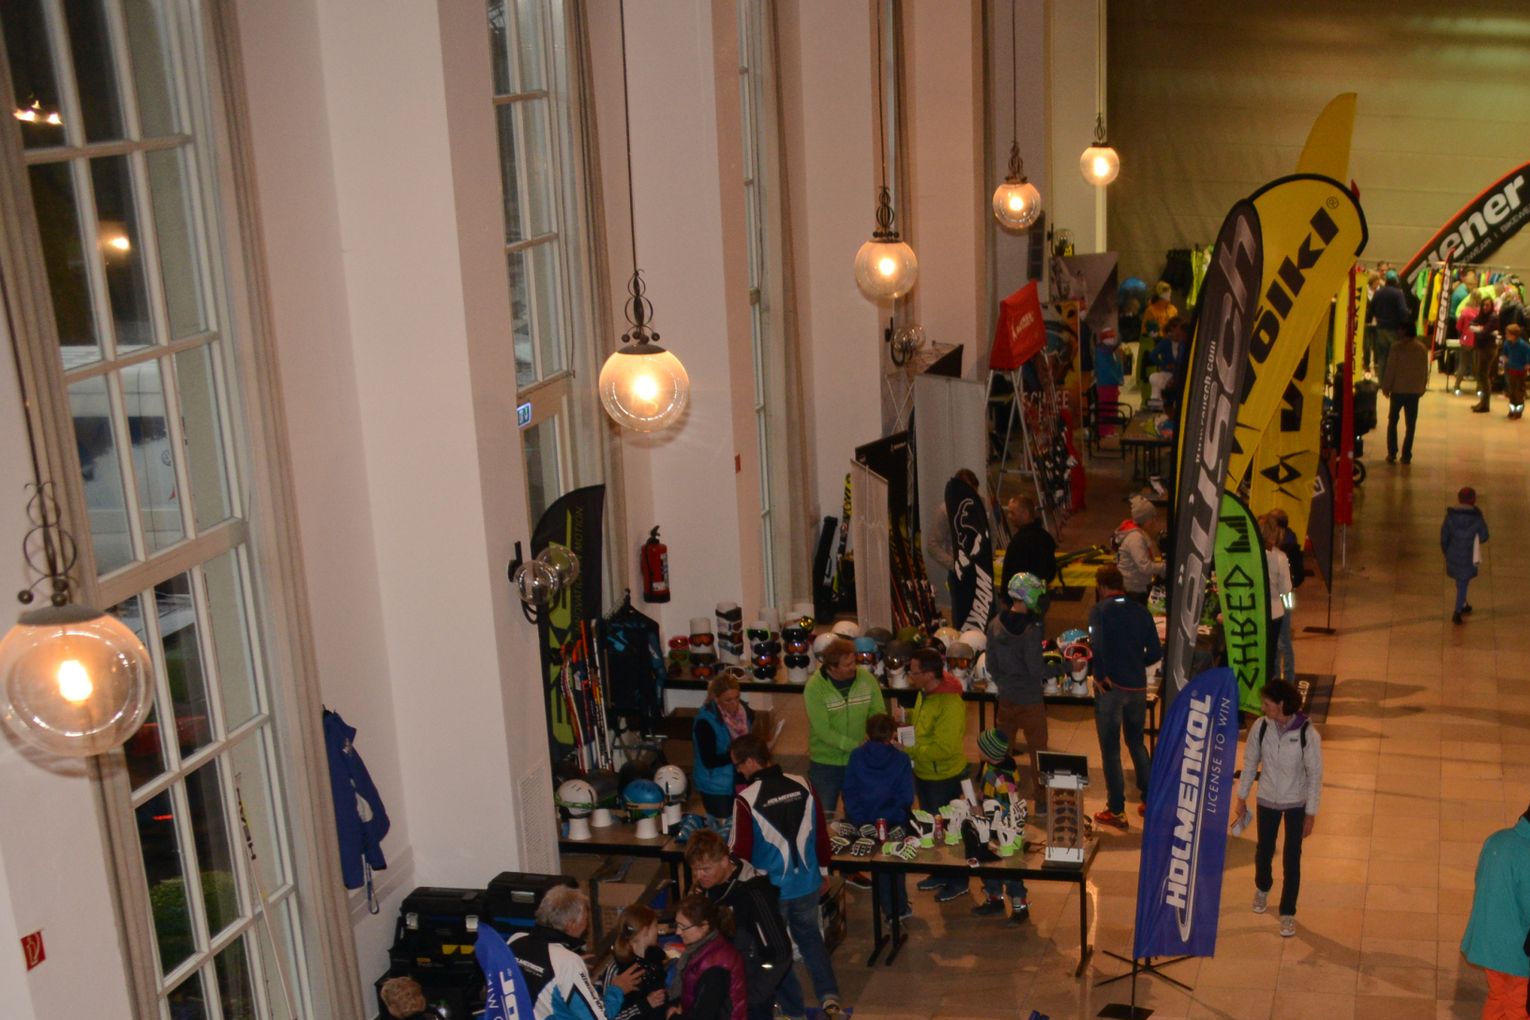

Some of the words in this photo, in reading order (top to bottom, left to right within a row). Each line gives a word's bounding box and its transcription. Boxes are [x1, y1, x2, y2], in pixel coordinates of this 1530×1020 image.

[1173, 213, 1256, 691] reusch
[1220, 697, 1231, 726] WIN
[1214, 732, 1226, 750] TO
[1165, 694, 1211, 909] HOLMENKOL
[1206, 757, 1223, 813] LICENSE
